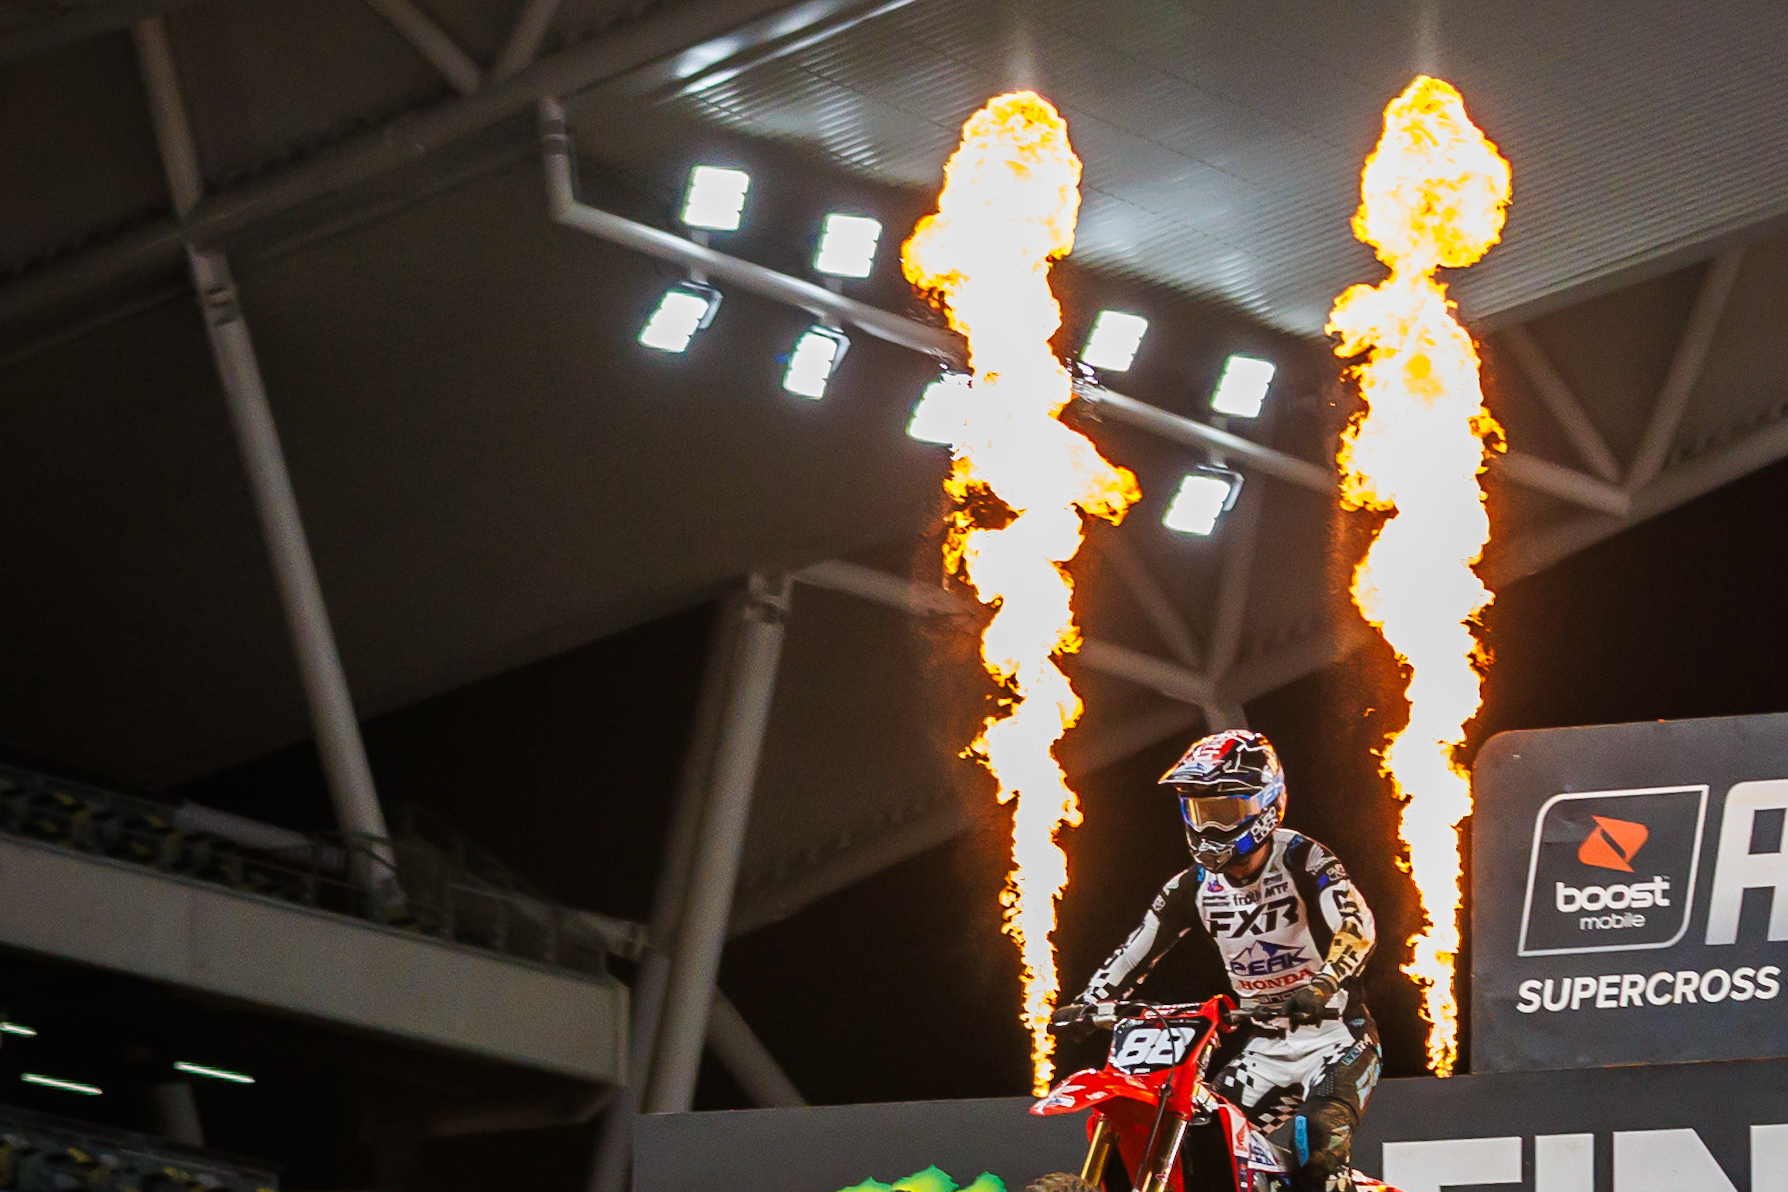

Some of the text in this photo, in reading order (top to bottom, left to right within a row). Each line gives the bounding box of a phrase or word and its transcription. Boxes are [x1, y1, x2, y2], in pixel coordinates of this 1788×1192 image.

[1555, 875, 1671, 913] boost
[1579, 911, 1646, 931] mobile
[1515, 965, 1781, 1014] SUPERCROSS
